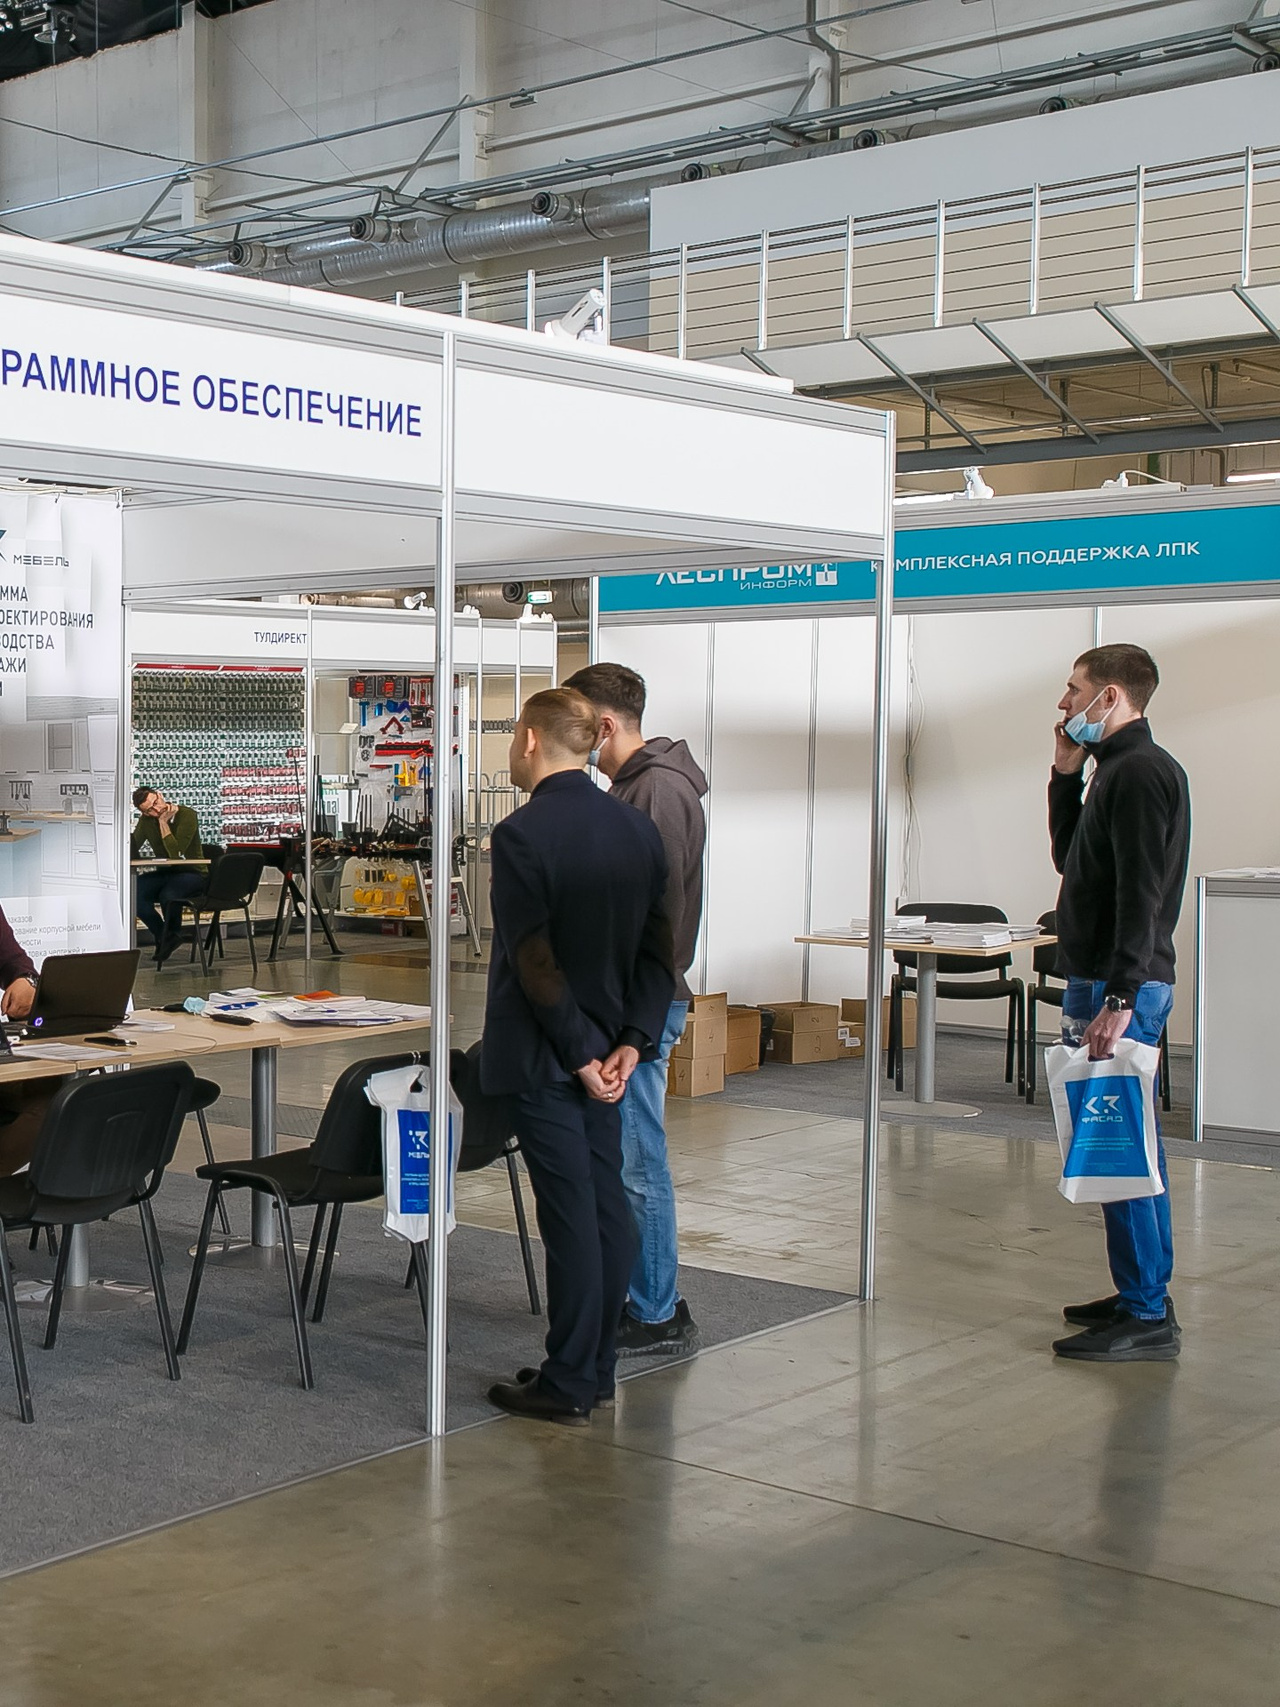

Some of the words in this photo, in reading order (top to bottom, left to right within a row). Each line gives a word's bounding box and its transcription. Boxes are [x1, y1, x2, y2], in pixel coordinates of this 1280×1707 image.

[192, 374, 422, 437] ОБЕСПЕЧЕНИЕ
[13, 554, 70, 567] МЕБЕЛЬ
[870, 553, 1012, 573] КМПЛЕКСНАЯ
[1017, 544, 1150, 566] ПОДДЕРЖКА
[1155, 541, 1201, 558] ЛПК
[740, 578, 812, 590] ИНФОРМ
[254, 631, 308, 645] ТУЛДИРЕКТ
[76, 922, 101, 932] мебели
